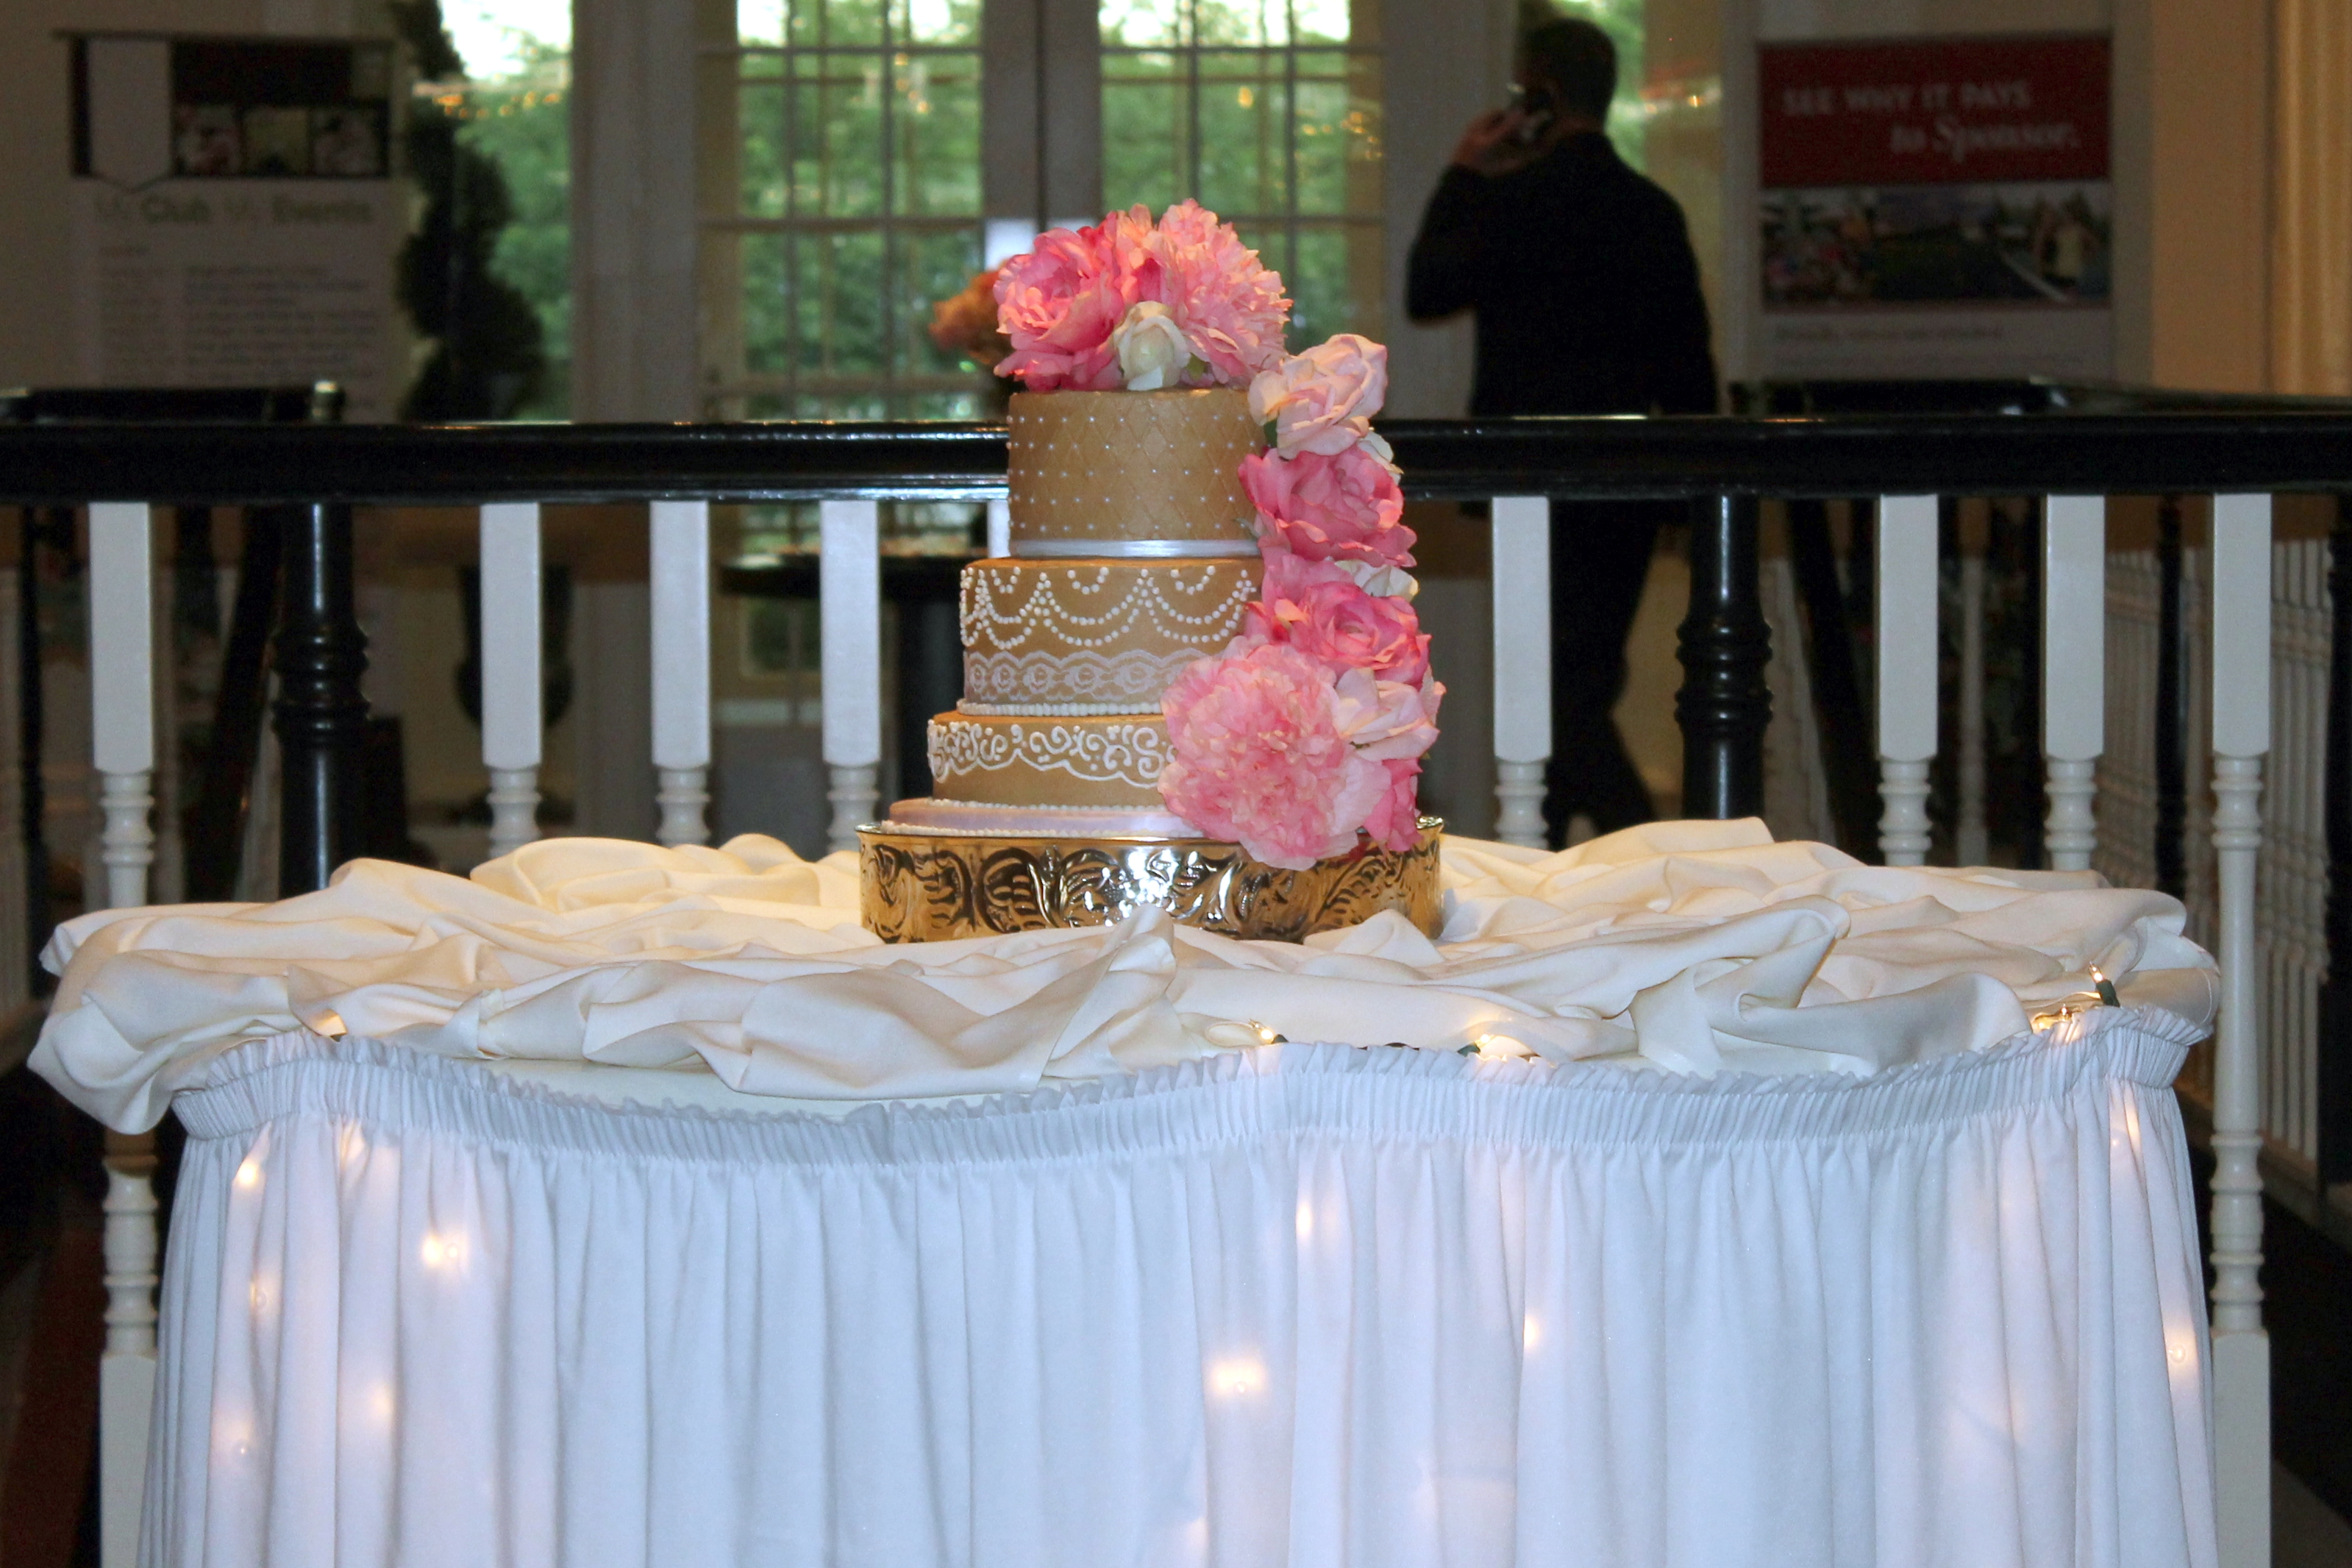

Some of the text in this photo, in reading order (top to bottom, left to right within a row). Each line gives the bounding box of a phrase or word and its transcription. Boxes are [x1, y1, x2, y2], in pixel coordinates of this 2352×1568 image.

[1845, 84, 1913, 113] WHY
[1922, 82, 1950, 110] IT
[1960, 79, 2032, 110] PAYS
